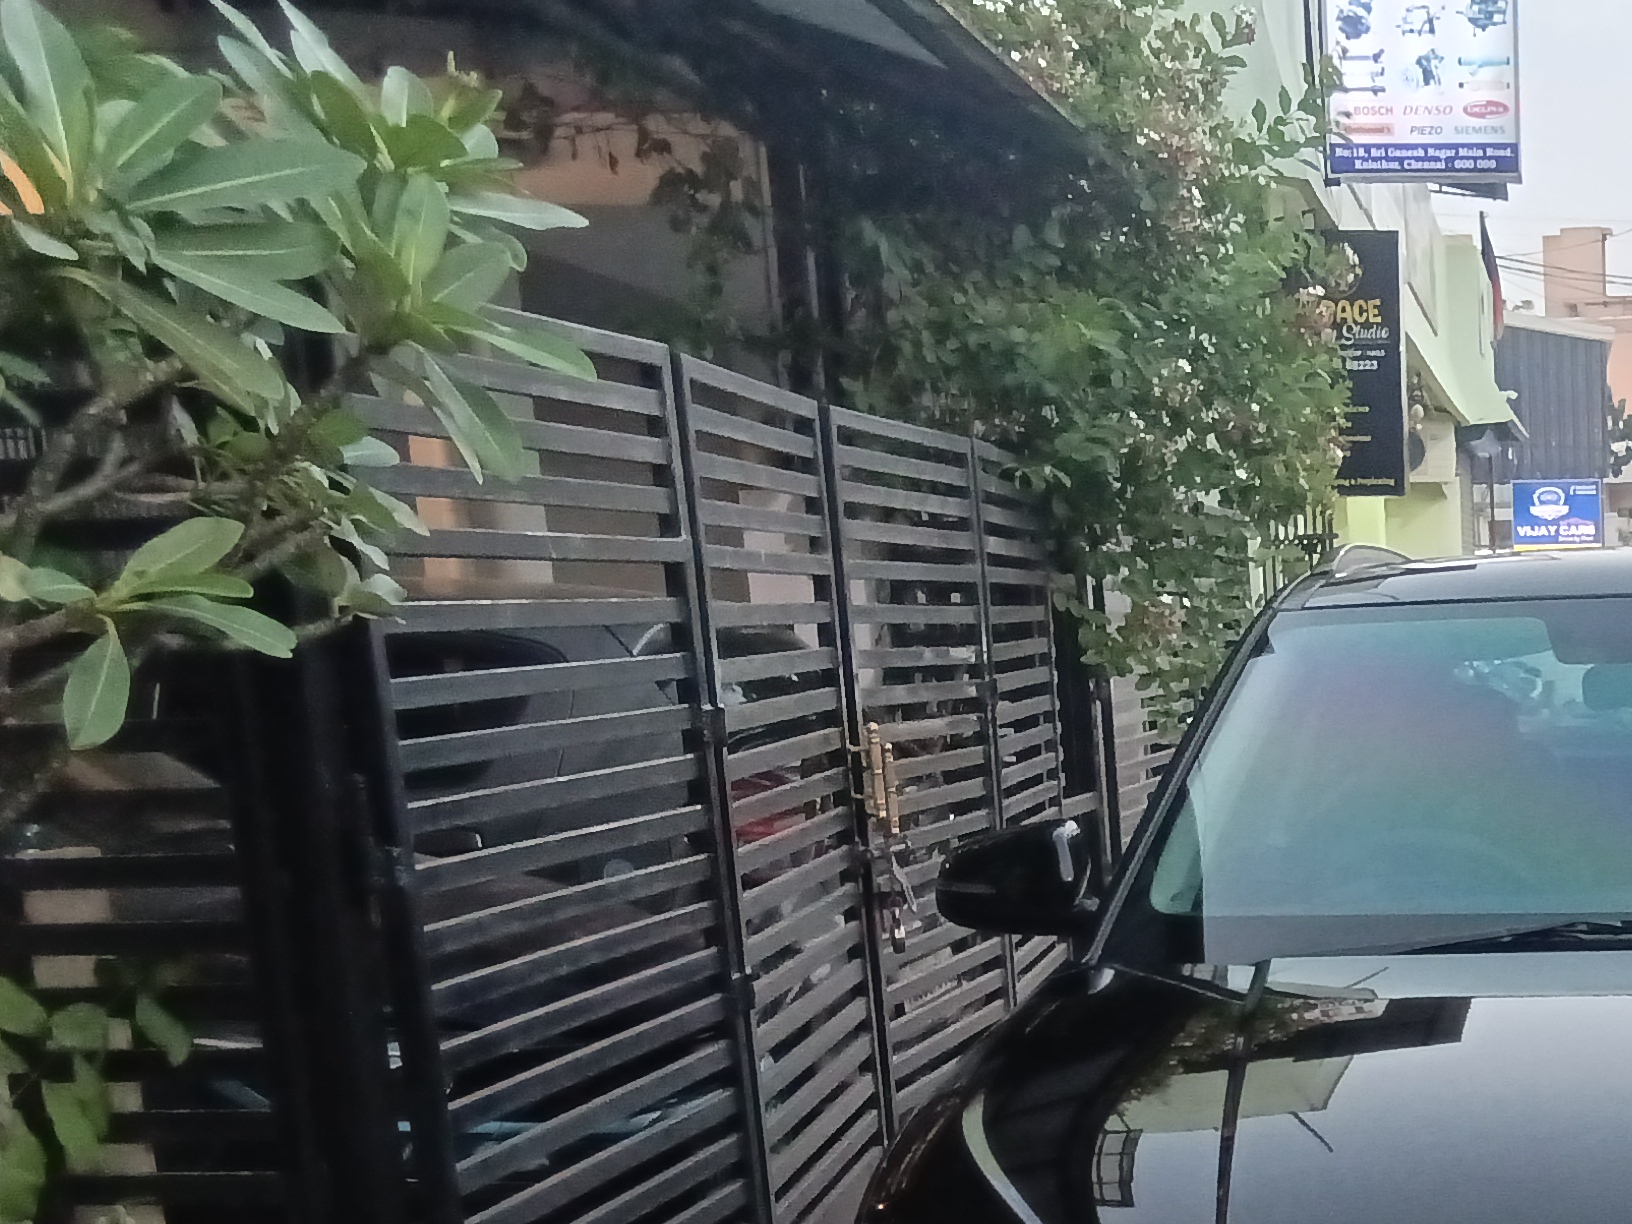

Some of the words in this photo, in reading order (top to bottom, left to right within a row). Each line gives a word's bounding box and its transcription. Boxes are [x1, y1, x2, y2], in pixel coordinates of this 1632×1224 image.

[1353, 105, 1394, 116] BOSCH
[1402, 104, 1454, 117] DENSO
[1409, 125, 1443, 136] PIEZO
[1454, 125, 1506, 136] SIEMENS
[1516, 525, 1558, 537] VIJAY
